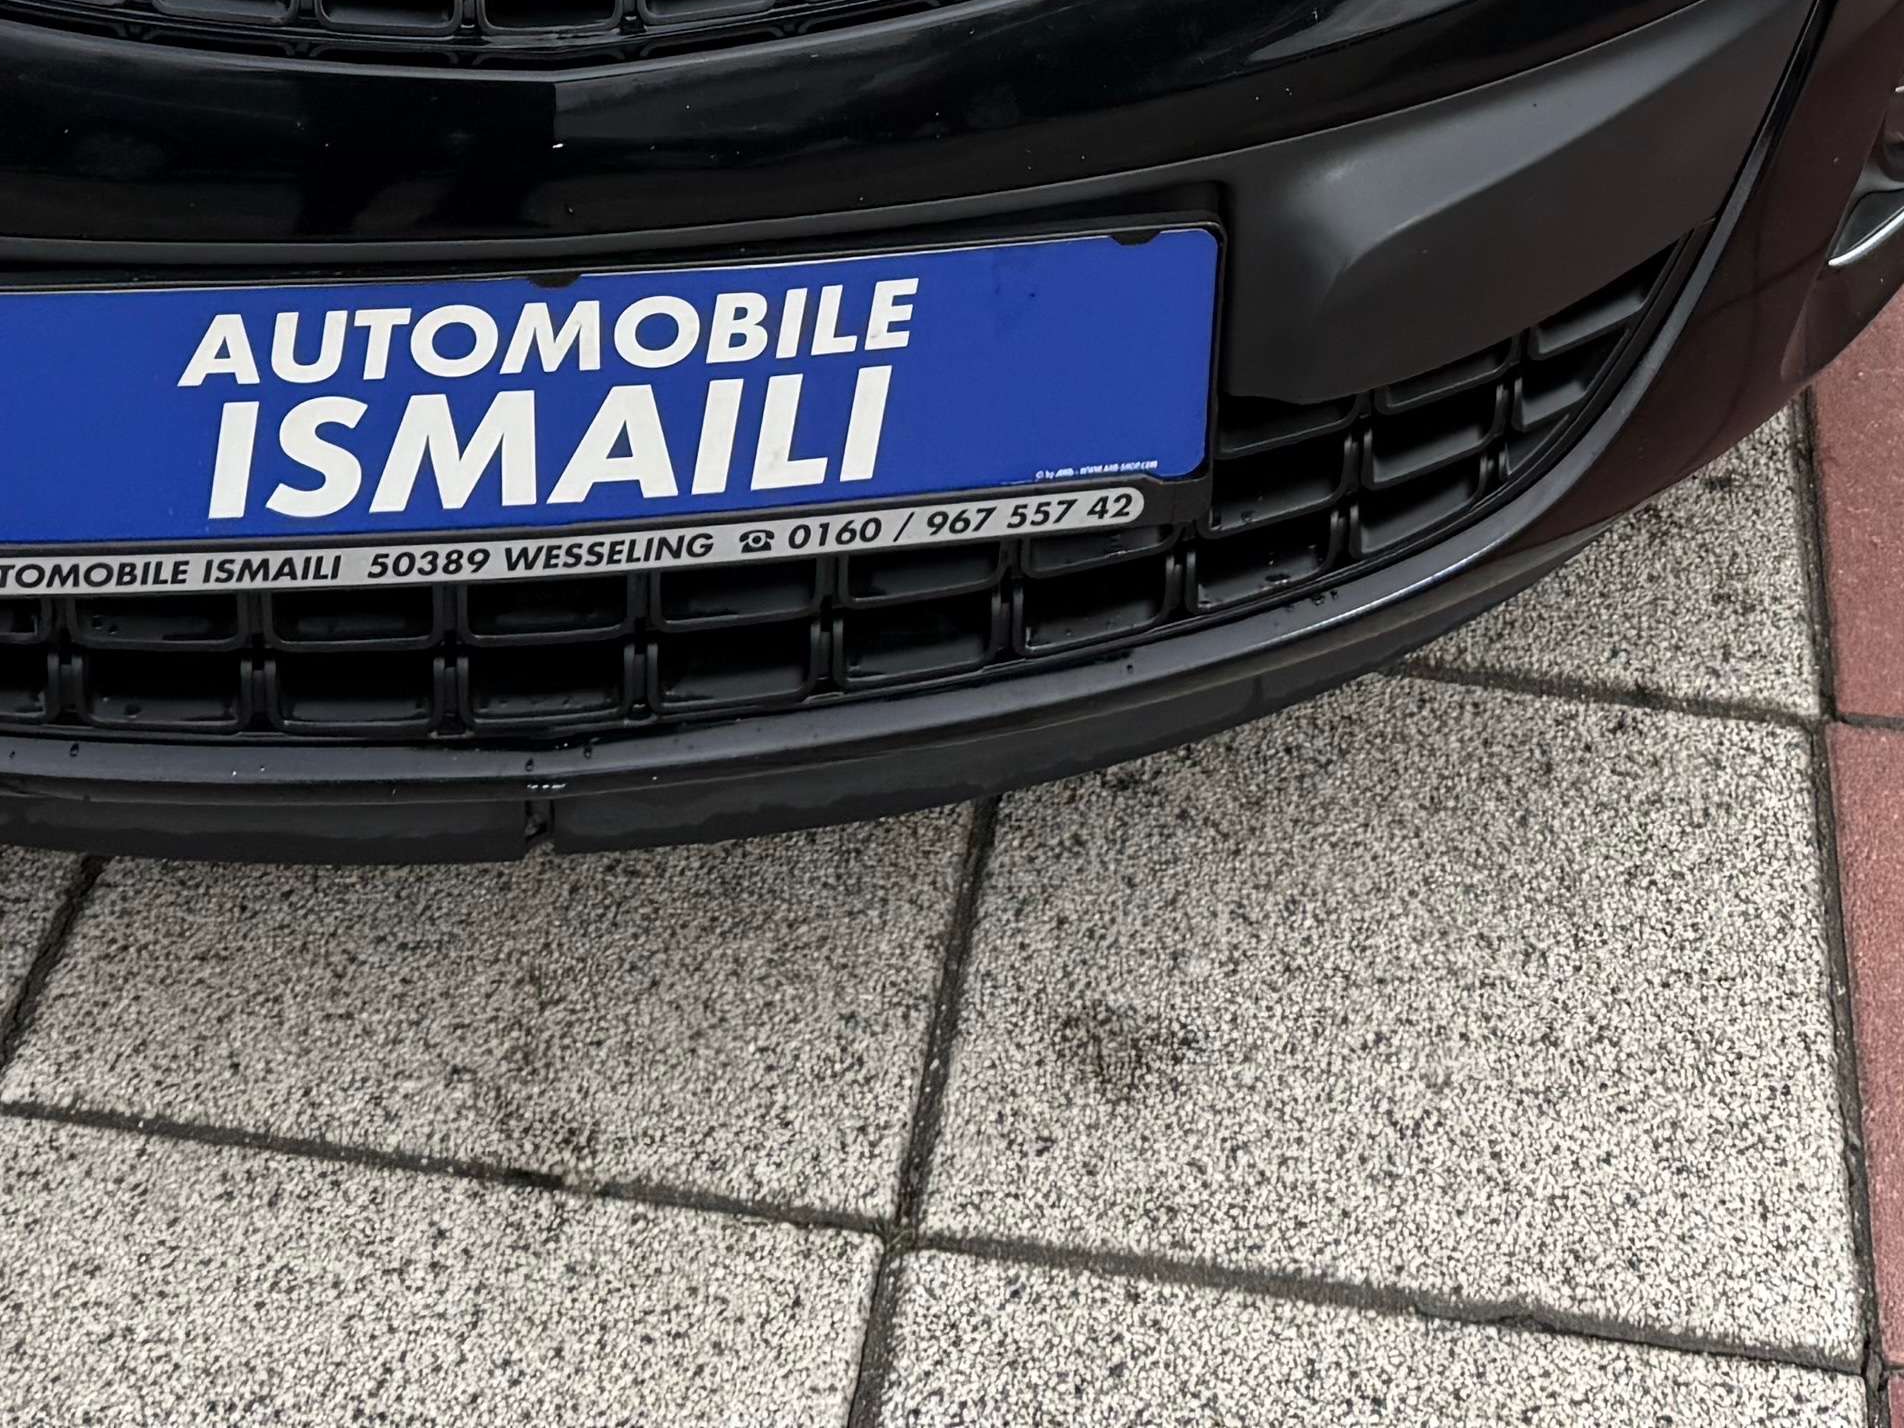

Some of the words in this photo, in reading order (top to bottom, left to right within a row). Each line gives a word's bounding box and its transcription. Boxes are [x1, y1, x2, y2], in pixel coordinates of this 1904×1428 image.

[177, 276, 921, 387] AUTOMOBILE
[207, 363, 894, 521] ISMAILI
[202, 555, 343, 585] ISMAILI
[367, 548, 491, 579] 50389
[504, 532, 714, 572] WESSELING
[788, 517, 882, 549] 0160
[893, 511, 915, 542] /
[926, 505, 998, 536] 967
[1006, 498, 1078, 529] 557
[1087, 492, 1134, 520] 42
